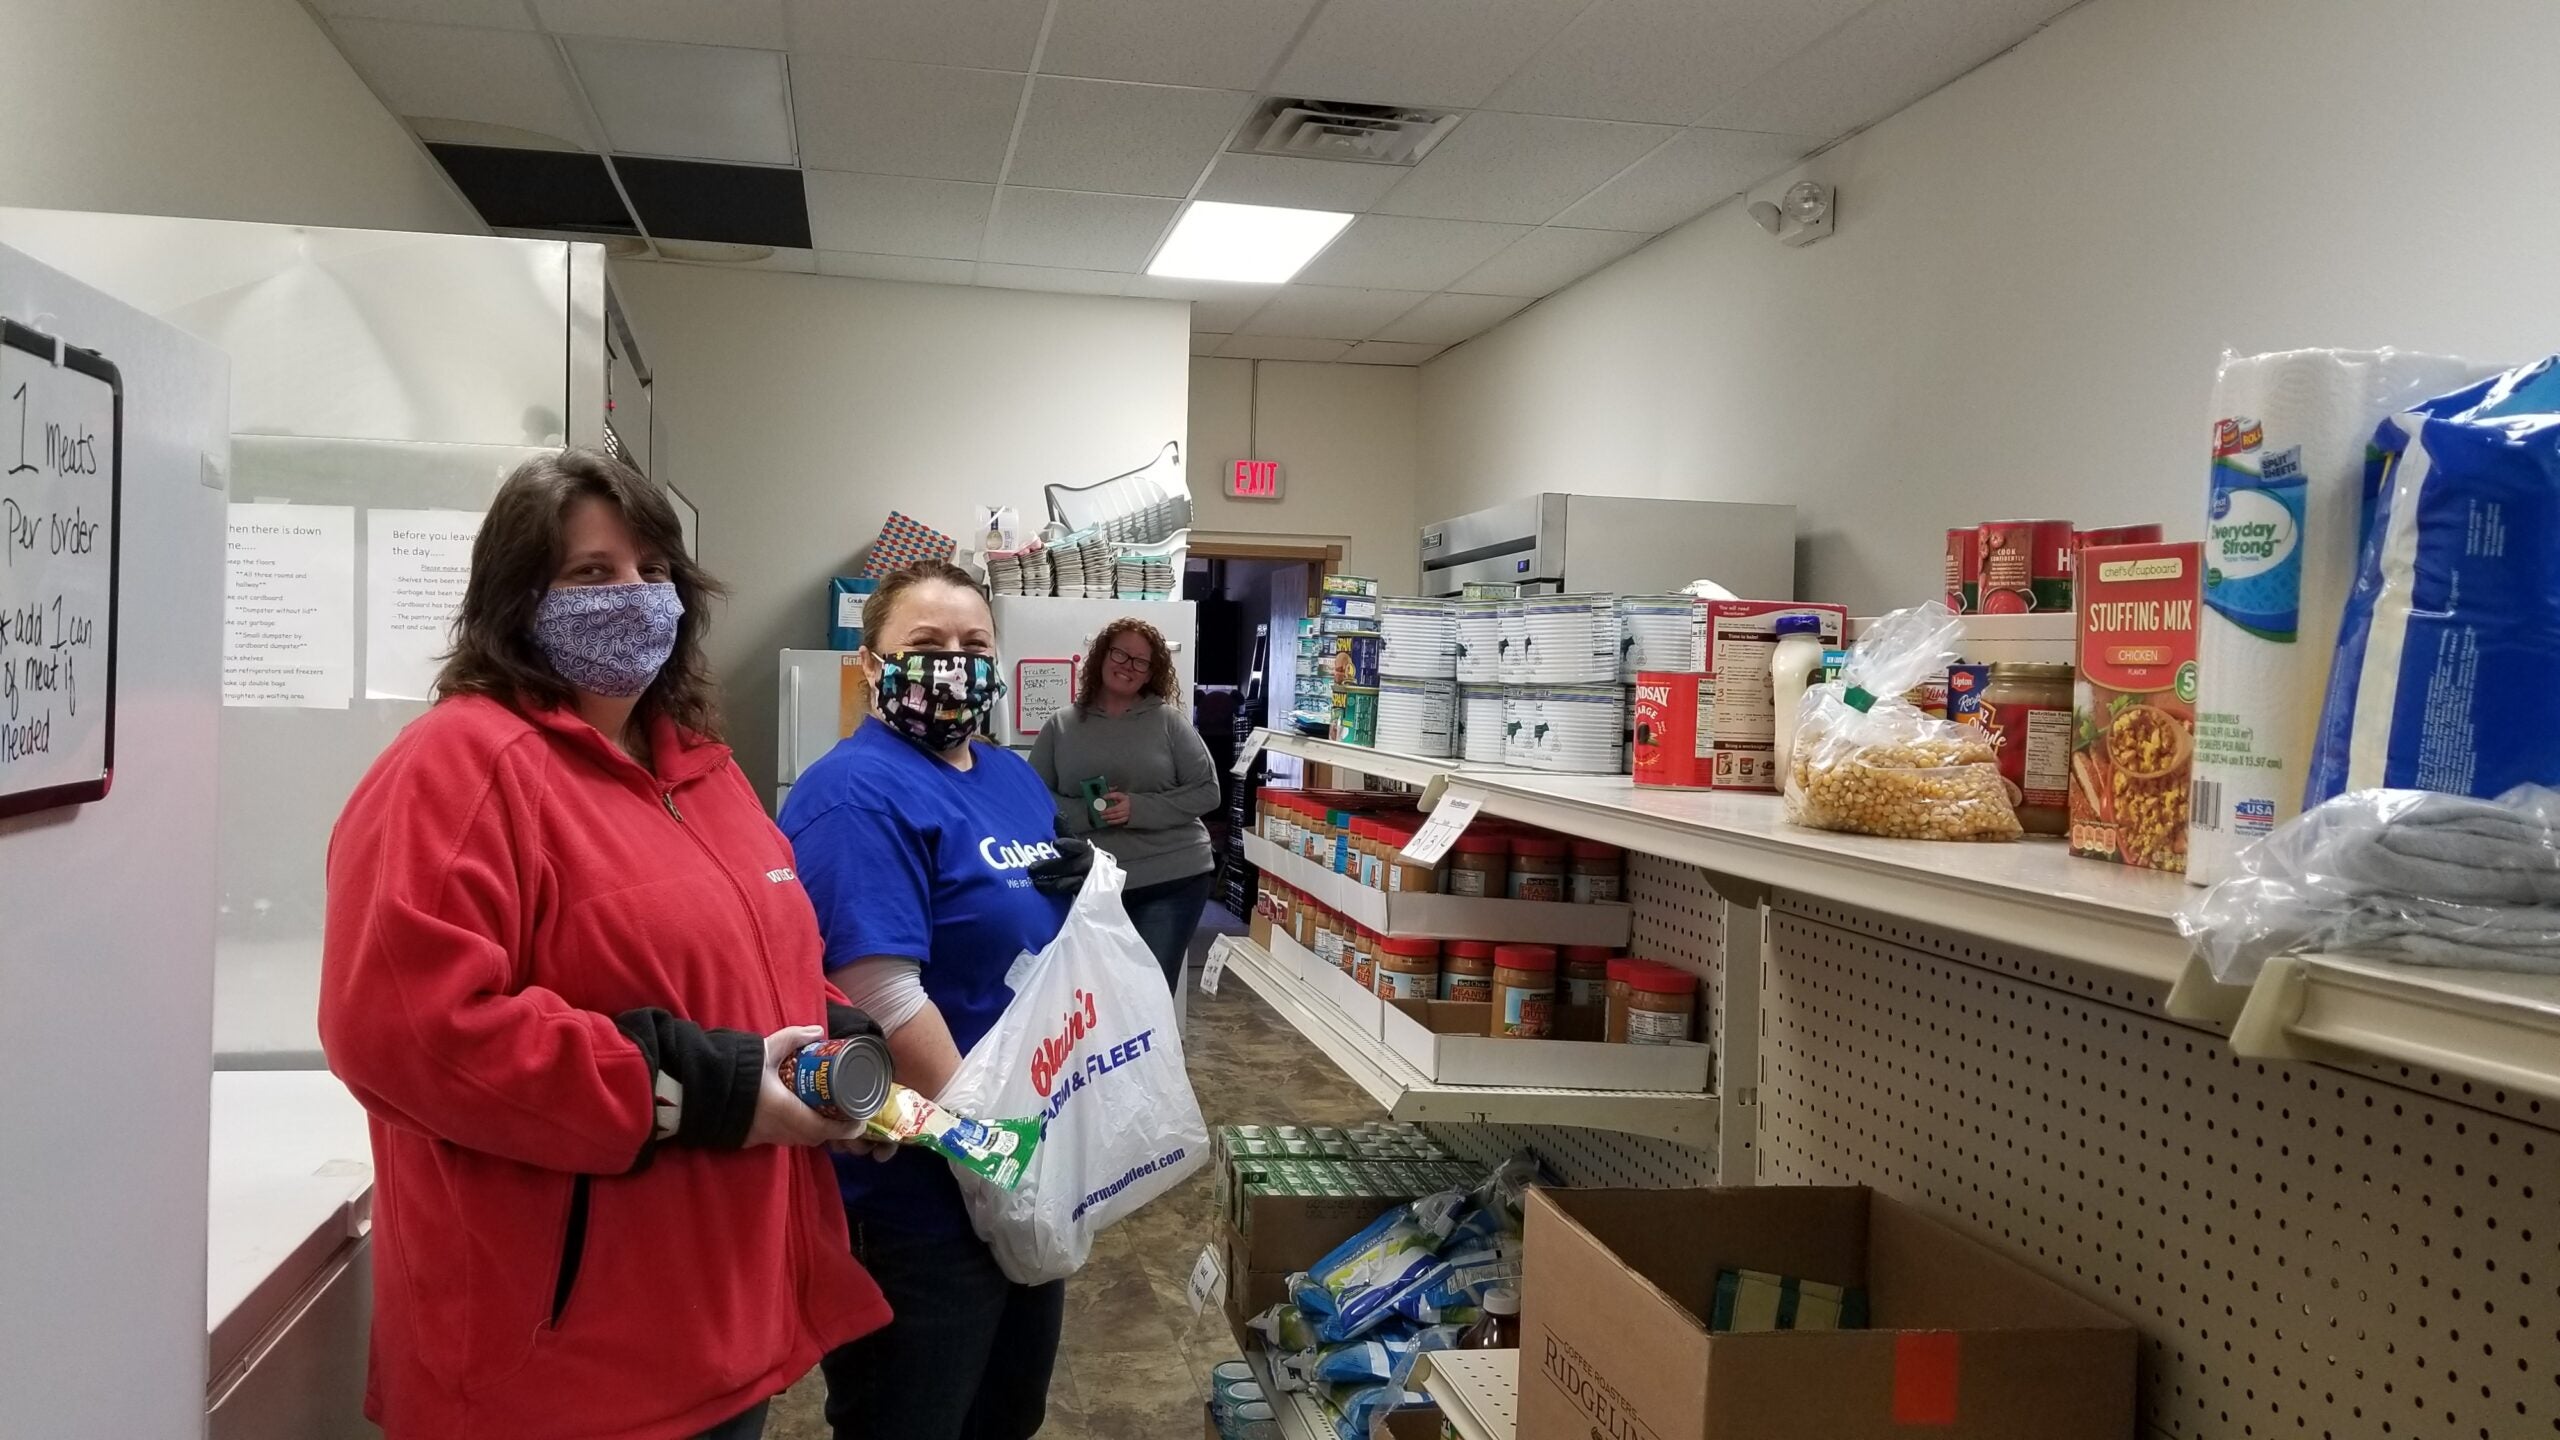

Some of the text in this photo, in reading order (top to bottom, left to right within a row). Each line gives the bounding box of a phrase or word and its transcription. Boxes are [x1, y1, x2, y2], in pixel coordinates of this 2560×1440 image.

[8, 382, 39, 475] 1
[2262, 455, 2288, 470] SPLIT
[2264, 461, 2298, 479] SHEETS
[1234, 461, 1278, 496] EXIT
[3, 498, 99, 567] Per order
[229, 524, 321, 535] hen there is down
[393, 530, 426, 540] Before
[451, 532, 477, 541] leave
[393, 547, 409, 556] the
[1997, 548, 2016, 556] COOK
[2222, 539, 2276, 558] Strong
[2136, 564, 2177, 576] cupboard
[2089, 599, 2193, 632] STUFFING MIX
[16, 603, 42, 647] add
[70, 616, 92, 648] can
[1336, 637, 1352, 652] SPAM
[2118, 650, 2158, 662] CHICKEN
[64, 650, 75, 716] if
[1952, 676, 1973, 688] Lipton
[2183, 672, 2196, 692] 5
[1332, 693, 1347, 708] SPAM
[1636, 685, 1672, 708] NDSAY
[1926, 688, 1947, 701] Libb
[1637, 706, 1658, 720] ARGE
[2, 708, 50, 763] needed
[2246, 804, 2273, 816] USA
[979, 836, 1061, 870] Coulee
[1030, 989, 1097, 1098] Blain's
[1072, 1071, 1086, 1092] &
[1086, 1030, 1152, 1084] FLEET
[1563, 1341, 1638, 1421] COFFEE ROASTERS
